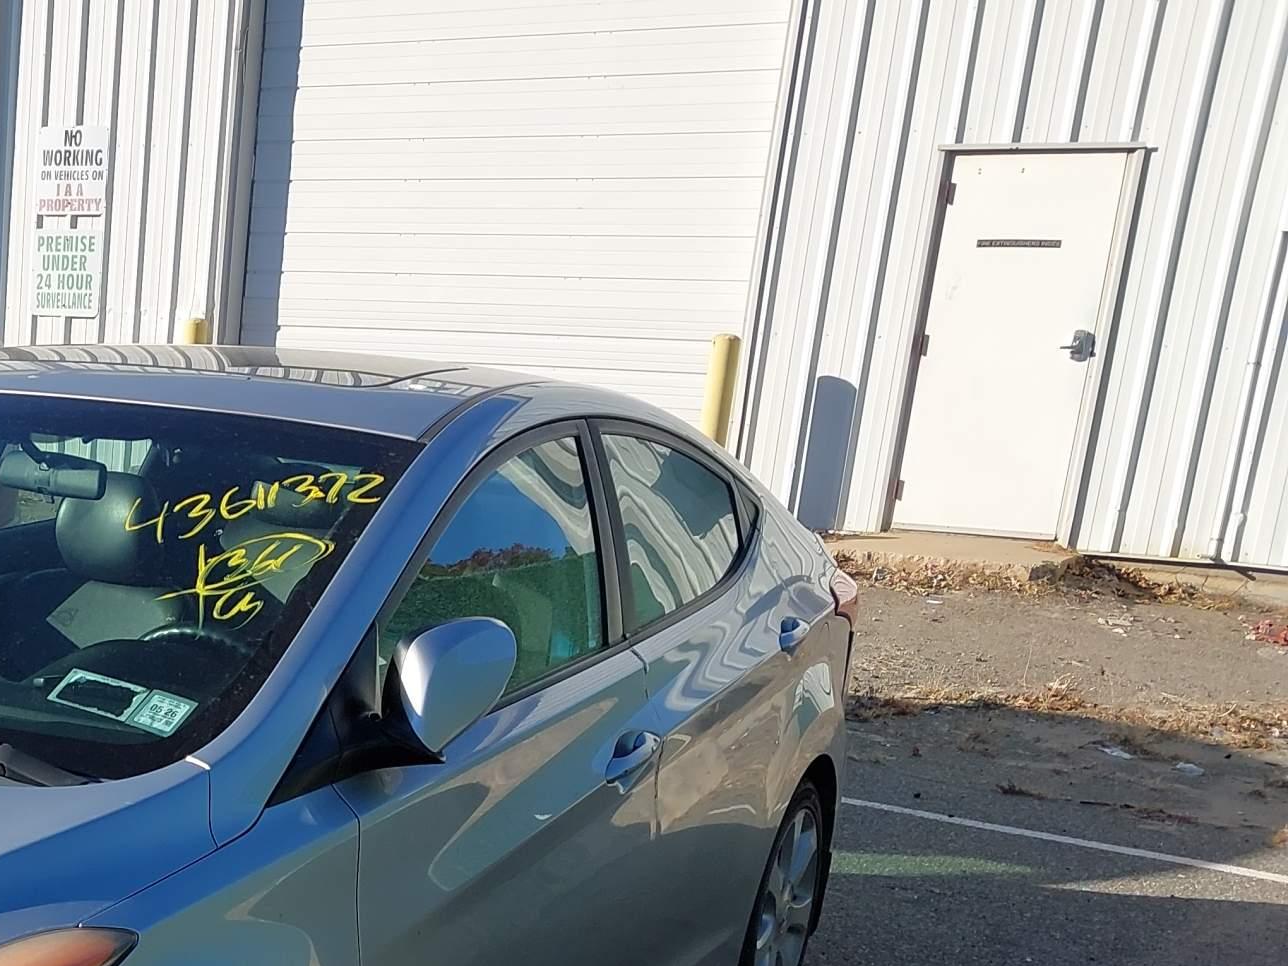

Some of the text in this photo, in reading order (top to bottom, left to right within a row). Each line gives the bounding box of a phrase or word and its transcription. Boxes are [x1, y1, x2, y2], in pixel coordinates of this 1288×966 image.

[64, 129, 82, 147] NO
[42, 149, 103, 166] WORKING
[40, 170, 104, 181] ON VEHICLES ON
[39, 198, 102, 212] PROPERTY
[37, 235, 96, 252] PREMISE
[42, 254, 87, 271] UNDER
[36, 273, 93, 290] 24 HOUR
[124, 472, 385, 544] 43611372
